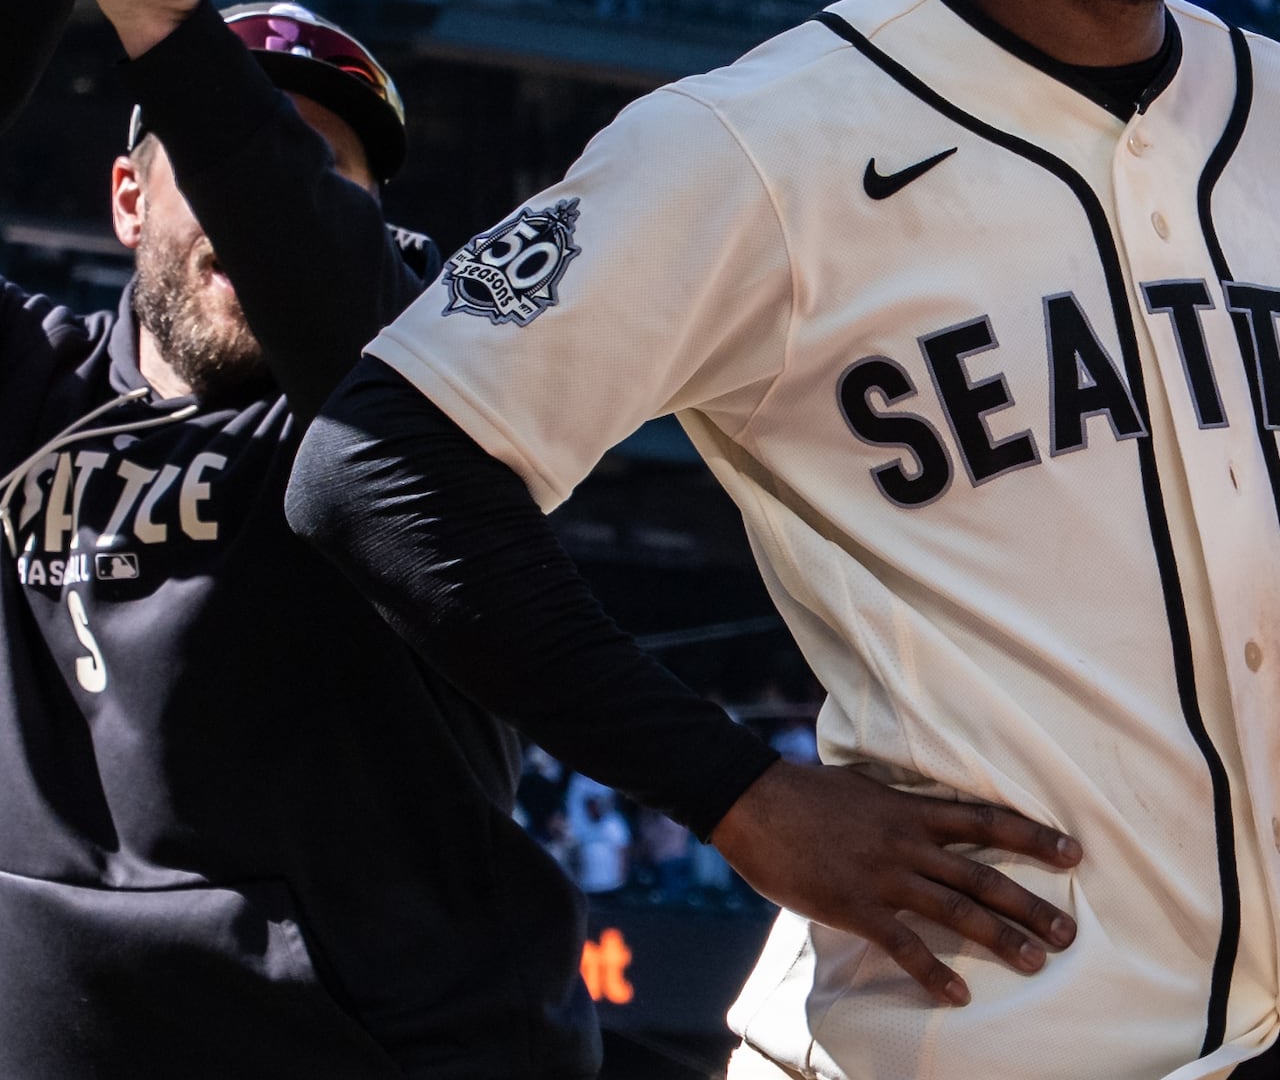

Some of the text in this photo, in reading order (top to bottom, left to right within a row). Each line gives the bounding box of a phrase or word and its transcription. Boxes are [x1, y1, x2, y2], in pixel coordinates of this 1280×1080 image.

[460, 263, 515, 308] seasons
[481, 222, 560, 290] 50
[67, 590, 108, 693] S
